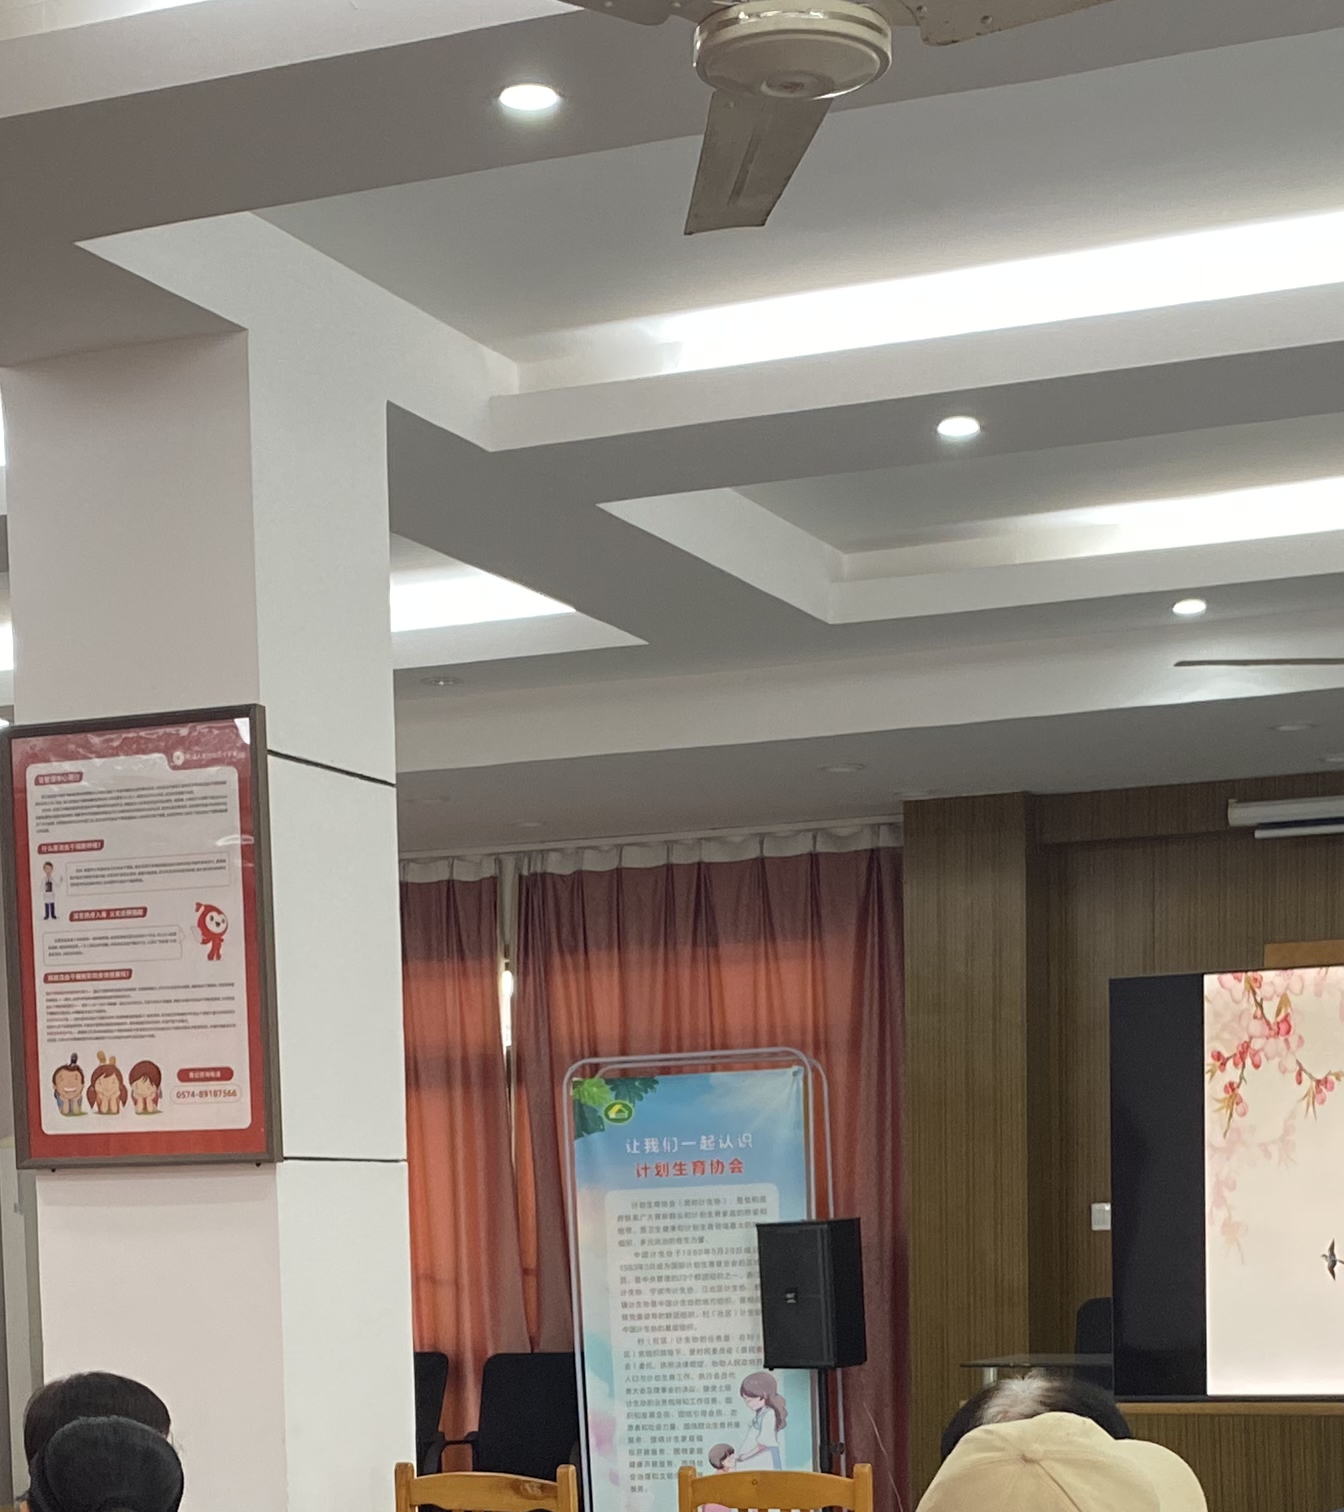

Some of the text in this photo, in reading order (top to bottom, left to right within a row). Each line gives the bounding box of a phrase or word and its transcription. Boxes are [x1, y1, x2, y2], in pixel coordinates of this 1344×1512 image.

[626, 1132, 753, 1154] 让我们一起认识
[635, 1158, 744, 1178] 计划生育协会
